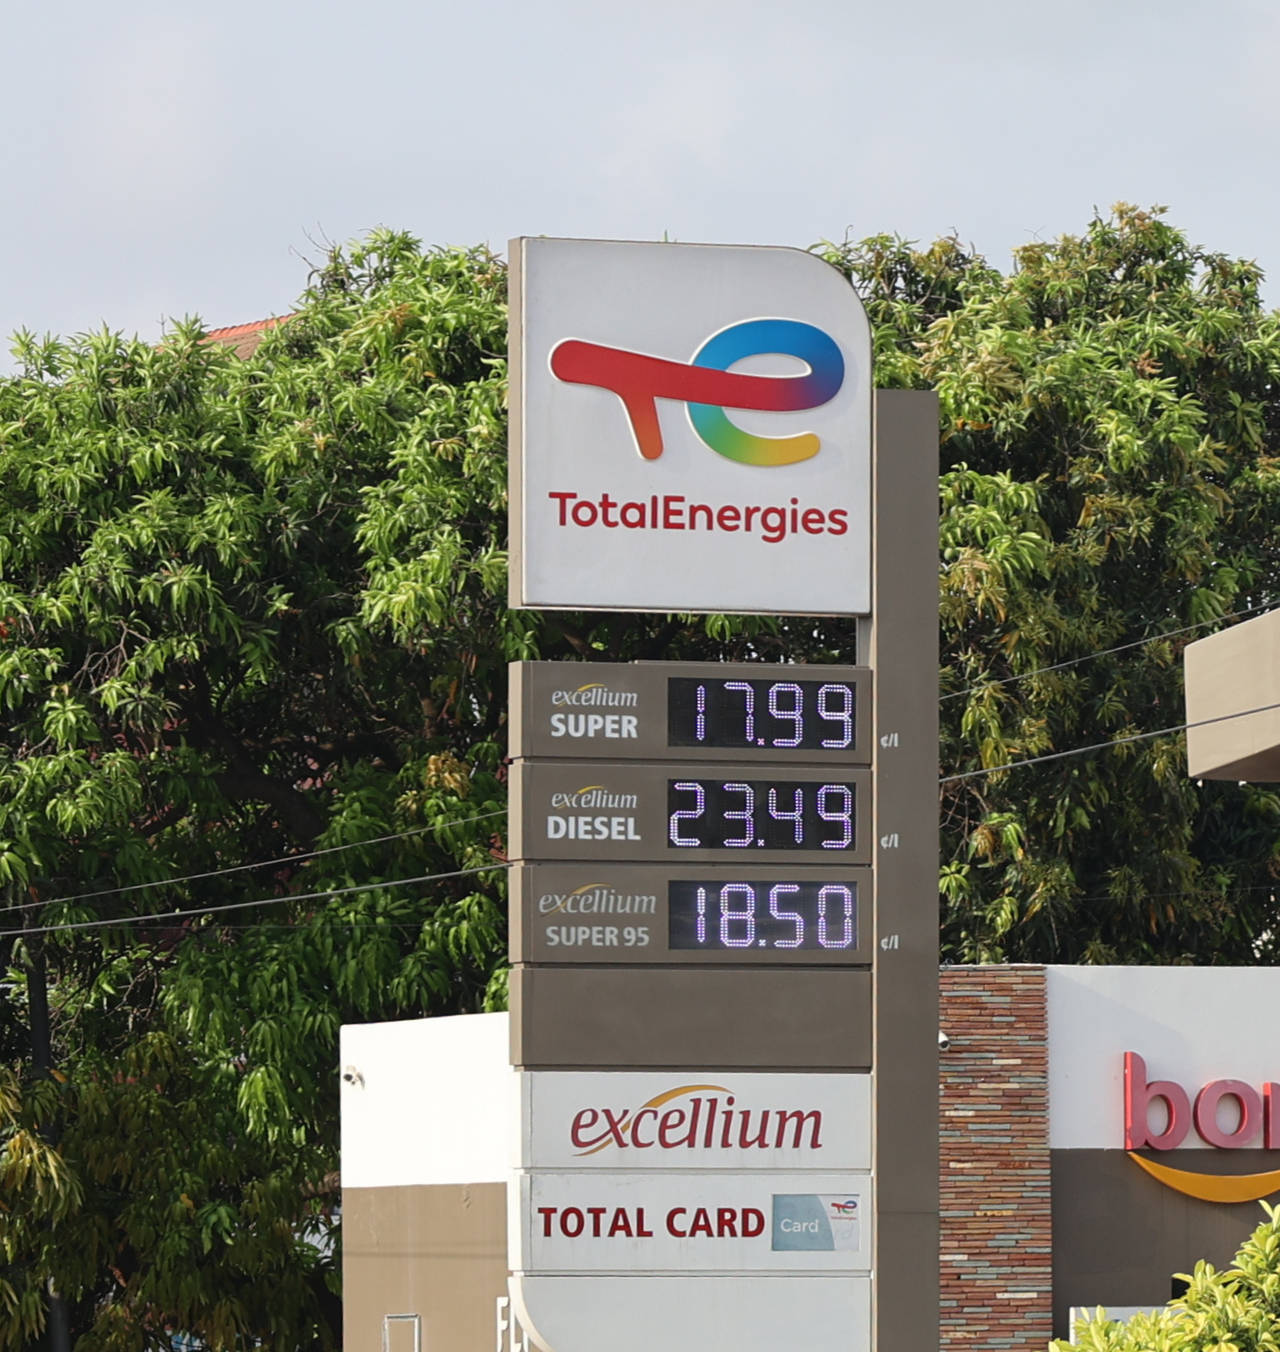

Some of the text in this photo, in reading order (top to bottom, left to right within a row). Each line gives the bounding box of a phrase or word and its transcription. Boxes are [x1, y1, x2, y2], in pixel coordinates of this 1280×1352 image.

[548, 492, 848, 543] TotalEnergies
[551, 684, 638, 707] excellium
[550, 713, 638, 739] SUPER
[696, 681, 852, 749] 17.99
[551, 786, 638, 810] excellium
[547, 816, 641, 841] DIESEL
[669, 782, 852, 848] 23.49
[538, 884, 656, 917] excellium
[696, 883, 852, 949] 18.50
[545, 926, 649, 947] SUPER 95
[570, 1090, 823, 1153] excellium
[538, 1207, 765, 1238] TOTAL CARD
[780, 1217, 819, 1234] Card
